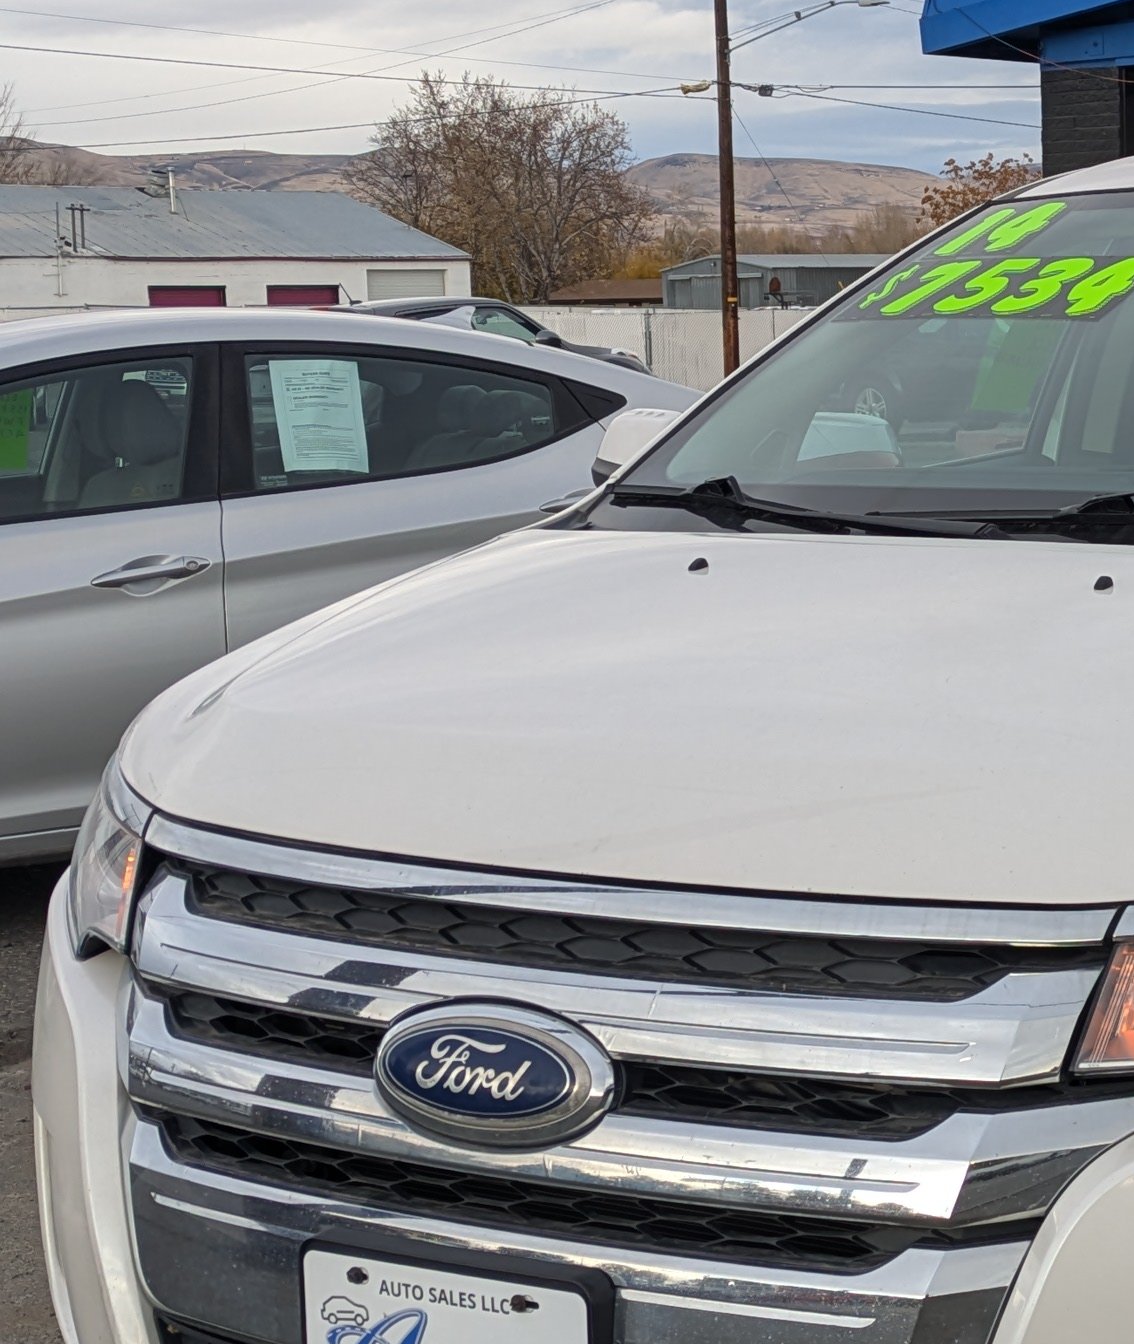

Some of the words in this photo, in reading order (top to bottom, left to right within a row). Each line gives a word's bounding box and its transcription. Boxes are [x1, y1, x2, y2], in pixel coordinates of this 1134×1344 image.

[933, 202, 1068, 256] 14
[415, 1034, 532, 1101] Ford
[378, 1279, 423, 1301] AUTO
[428, 1287, 476, 1309] SALES
[481, 1295, 511, 1315] LLC
